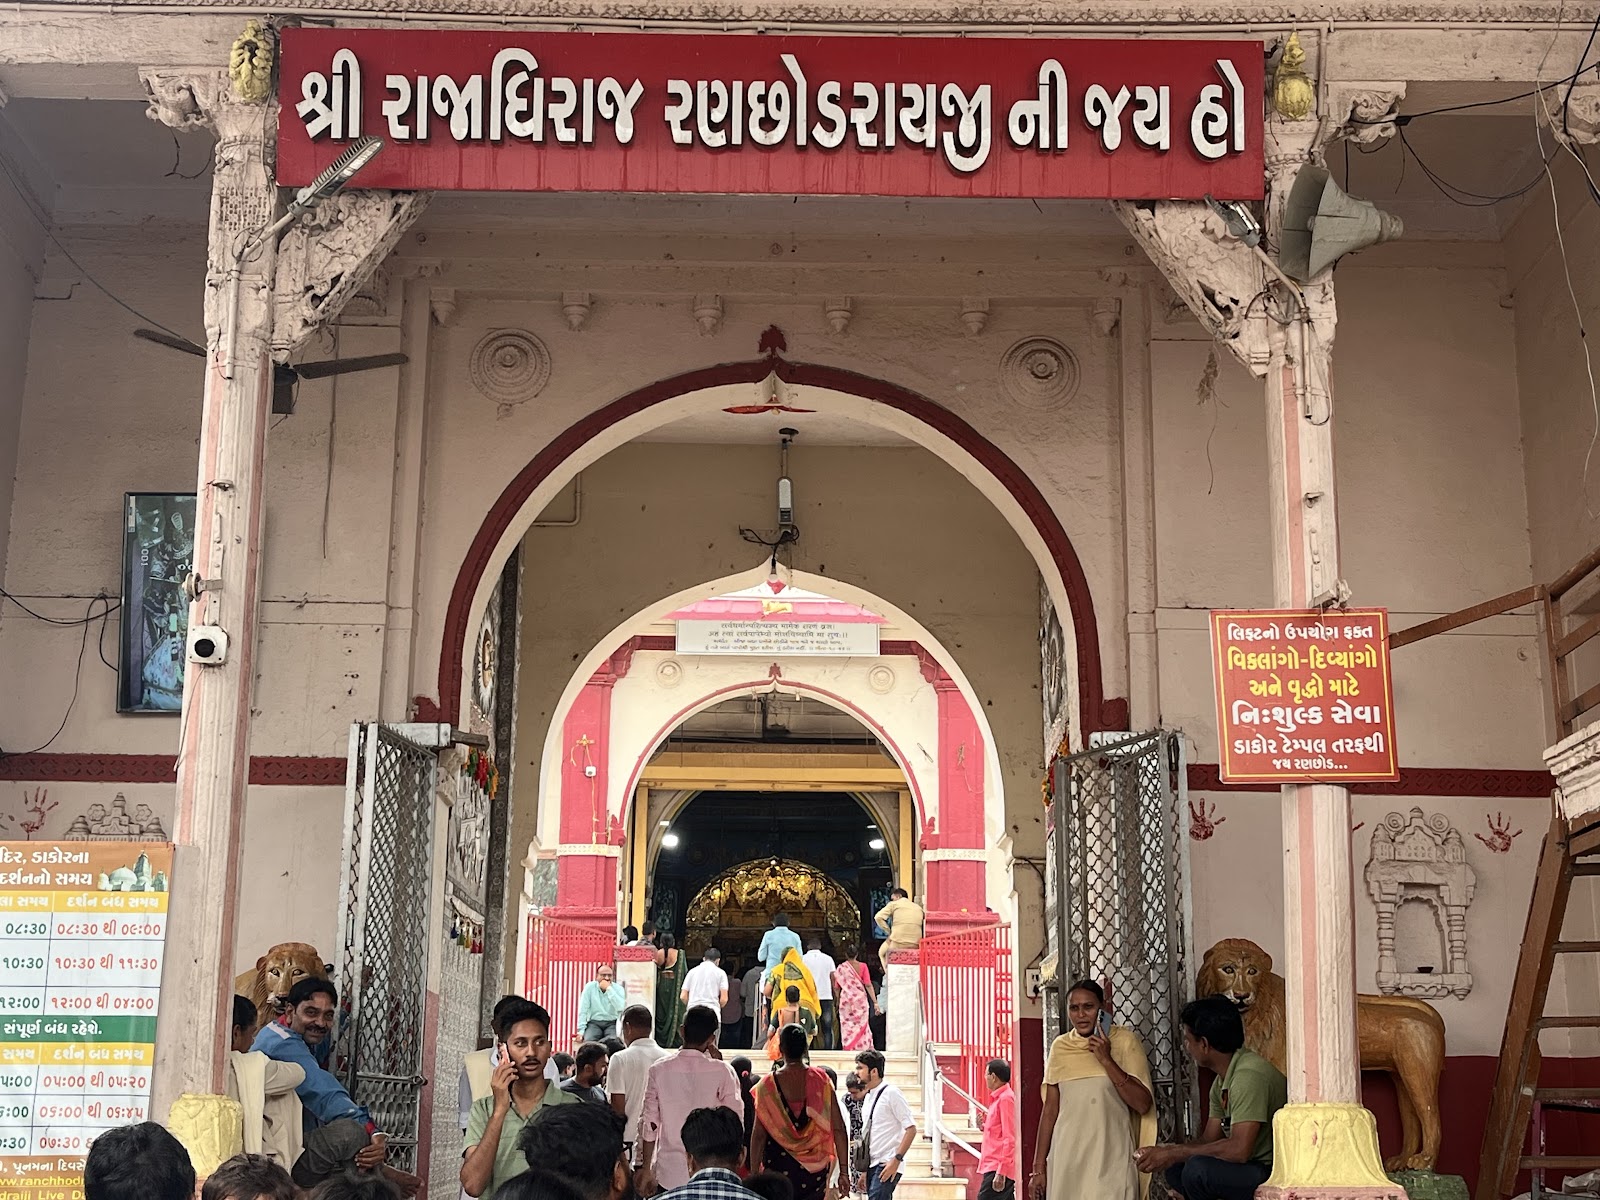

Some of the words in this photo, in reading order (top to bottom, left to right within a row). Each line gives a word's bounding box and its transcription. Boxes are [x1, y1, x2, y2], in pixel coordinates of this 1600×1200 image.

[295, 48, 362, 139] શ્રી
[381, 47, 645, 144] રાજાધિરાજ
[664, 54, 992, 172] રણછોડરાયજી
[1008, 58, 1069, 149] ની
[1084, 83, 1171, 151] જય
[1190, 59, 1245, 159] હો
[1284, 621, 1339, 641] ઉપયોગ
[1249, 673, 1282, 697] અને
[1329, 671, 1360, 697] માટે
[1330, 698, 1381, 724] સેવા
[1233, 733, 1278, 755] ડાકોર
[1279, 733, 1327, 754] ટેમ્પલ
[1331, 731, 1385, 755] તરફથી
[1272, 758, 1291, 769] જય
[0, 846, 27, 865] દિર,
[31, 846, 90, 864] ડાકોરના
[55, 873, 92, 885] સમય
[17, 896, 49, 907] સમય
[66, 892, 98, 908] દર્શન
[128, 896, 159, 908] સમય
[103, 919, 117, 936] થી
[100, 953, 113, 970] થી
[96, 993, 109, 1010] થી
[45, 1019, 68, 1034] બંધ
[0, 1075, 32, 1087] ૫:૦૦
[91, 1071, 104, 1088] થી
[87, 1102, 102, 1118] થી
